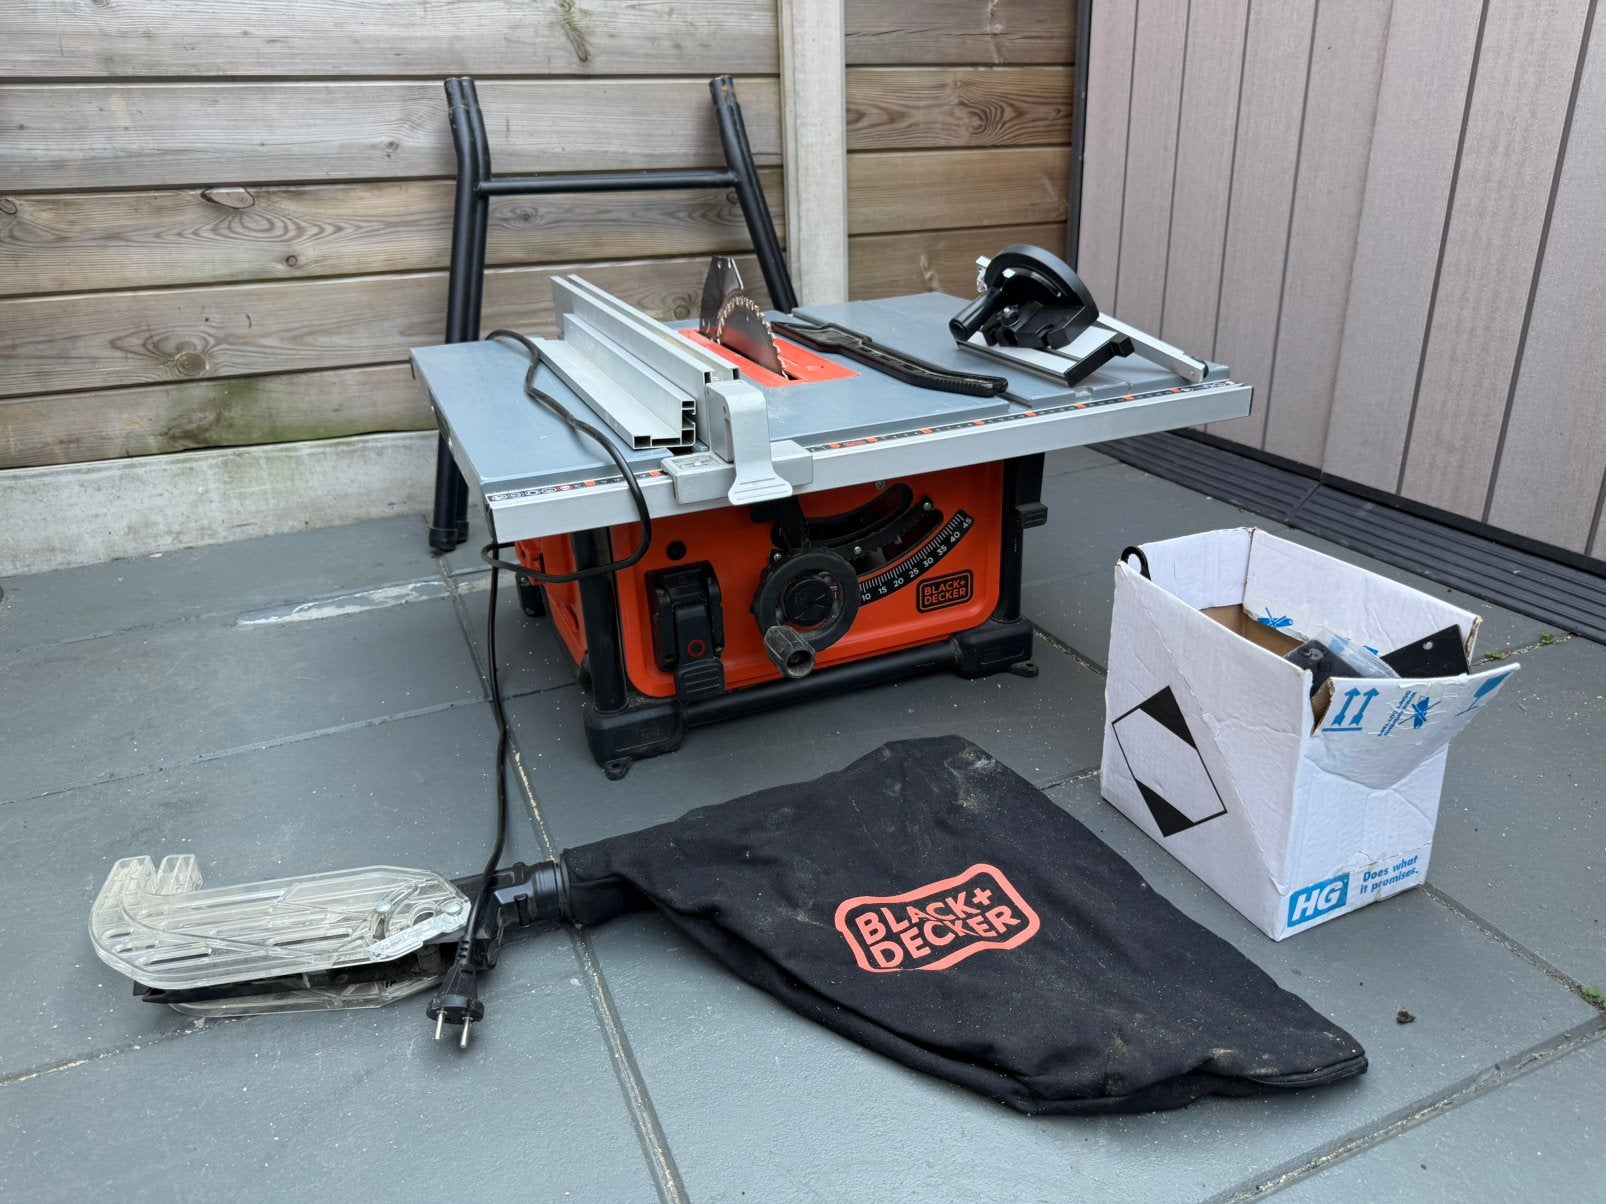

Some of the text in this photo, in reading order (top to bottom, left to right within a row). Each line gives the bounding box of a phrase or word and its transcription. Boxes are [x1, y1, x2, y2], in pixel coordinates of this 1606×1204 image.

[861, 517, 972, 602] 10 15 20 25 30 35 40 45
[924, 579, 966, 596] BLACK+
[924, 587, 967, 605] DECKER
[1360, 867, 1419, 894] it promises.
[1363, 855, 1419, 883] Does what
[855, 887, 992, 945] BLACK+
[1291, 880, 1343, 922] HG
[870, 905, 1021, 968] DECKER
